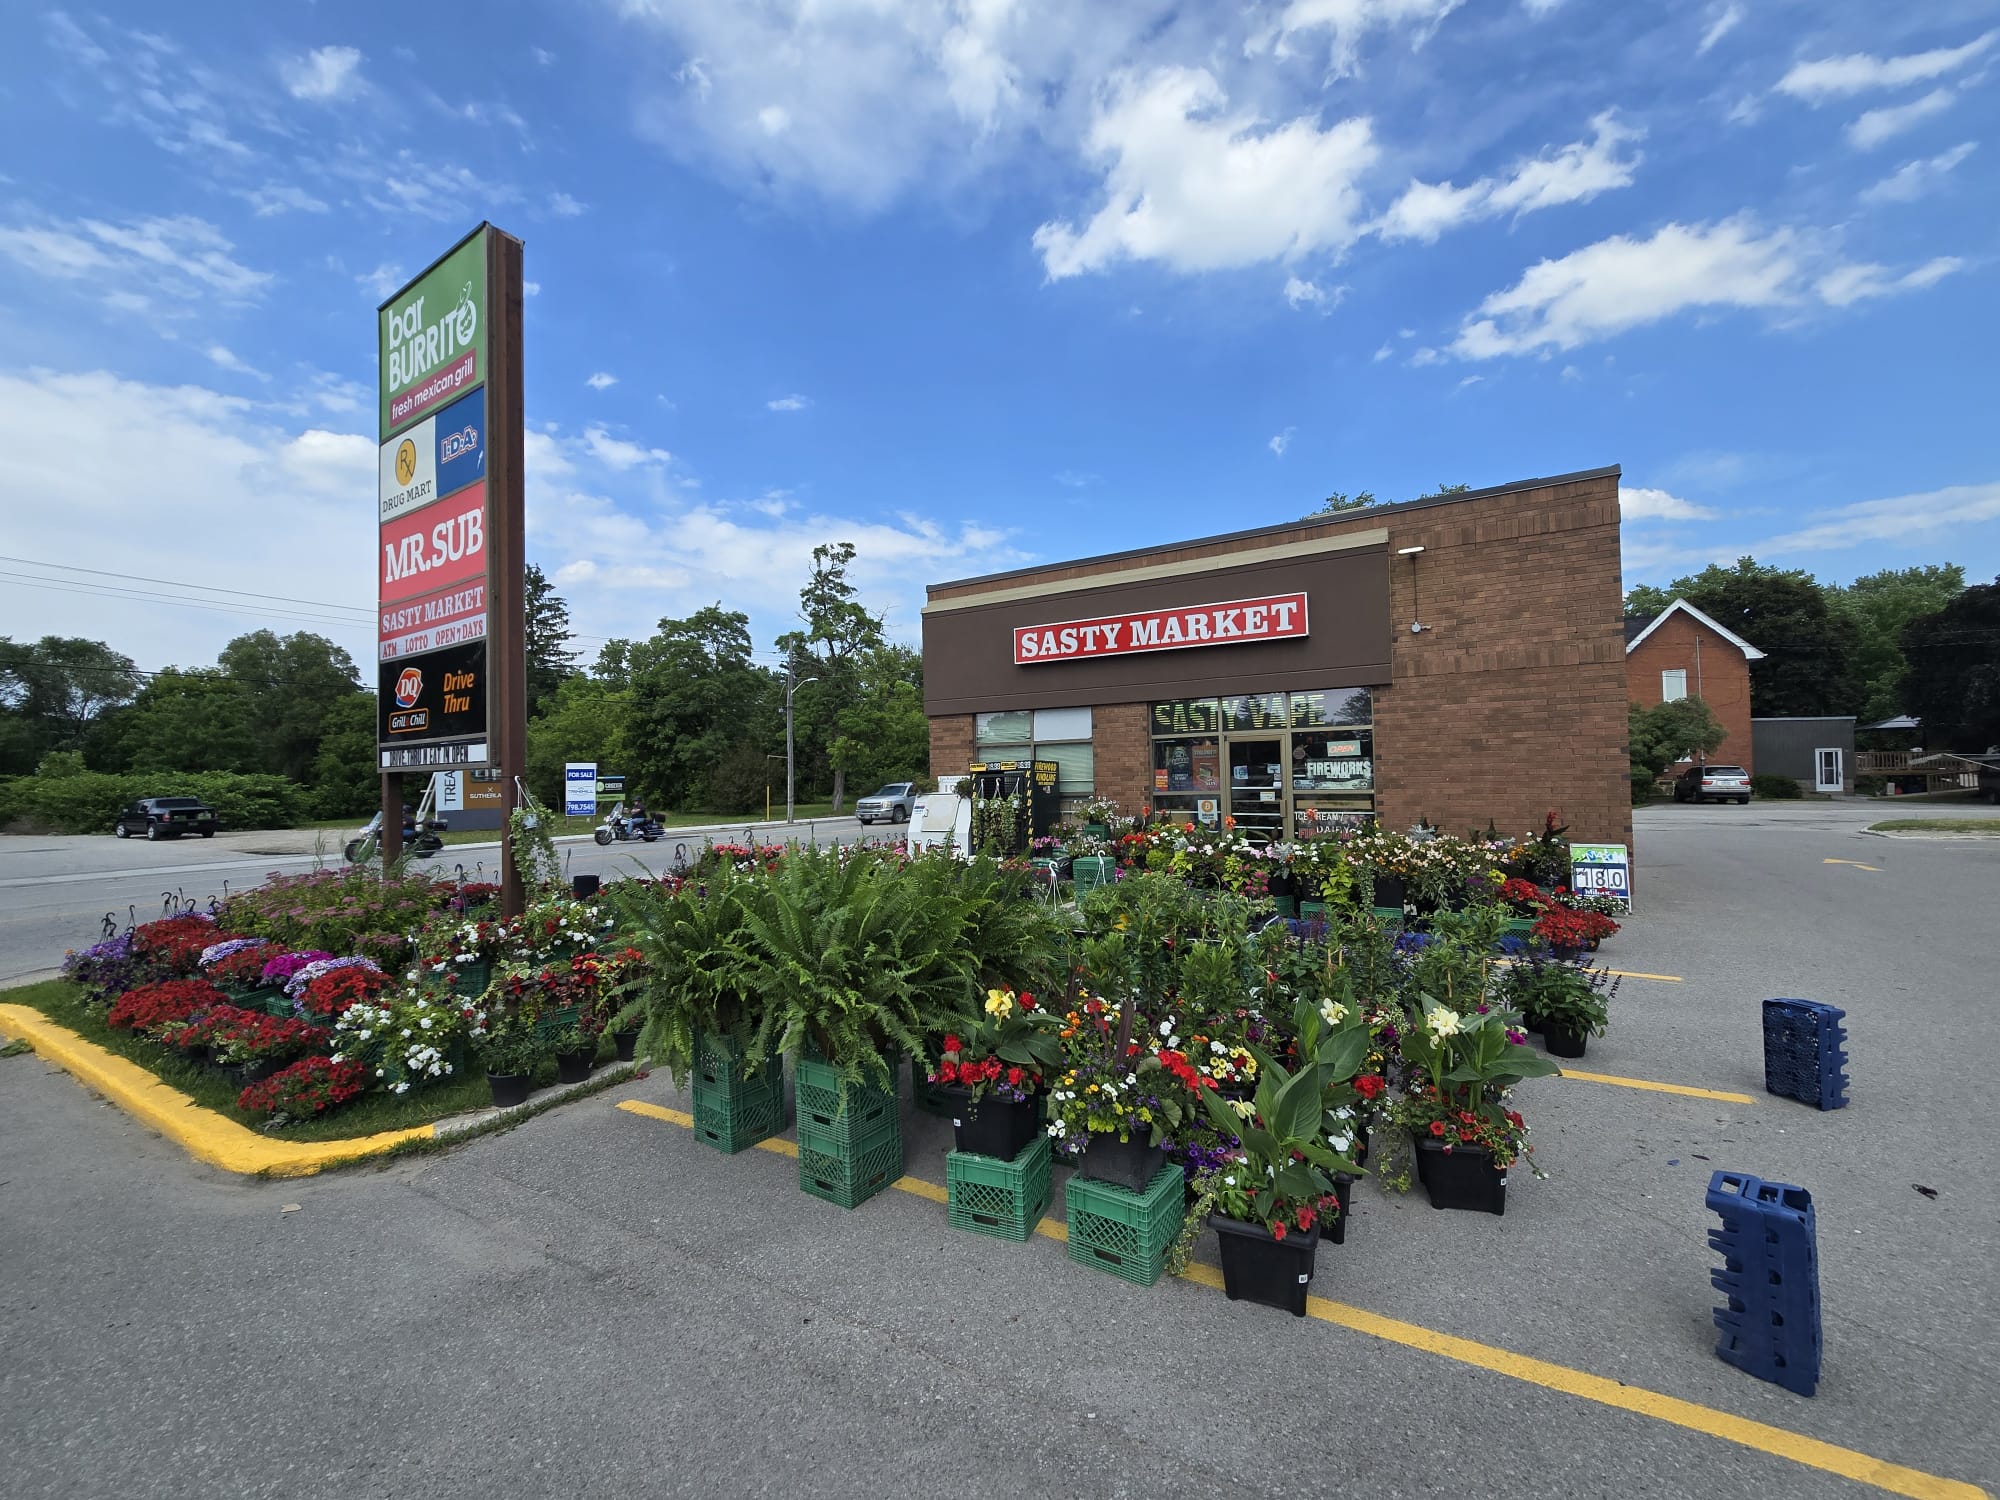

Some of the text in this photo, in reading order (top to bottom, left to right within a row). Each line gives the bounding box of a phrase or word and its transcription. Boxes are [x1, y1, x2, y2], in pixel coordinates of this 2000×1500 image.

[389, 296, 424, 350] bar
[389, 300, 477, 393] BURRITO
[392, 356, 473, 420] fresh mexican grill
[382, 480, 432, 513] DRUG MART
[382, 586, 484, 633] SASTY MARKET
[382, 619, 484, 658] ATM LOTTO OPEN 7 DAYS
[1021, 601, 1298, 658] SASTY MARKET
[400, 677, 417, 697] DQ
[443, 670, 475, 692] Drive
[443, 693, 470, 714] Thru
[1248, 694, 1326, 728] VAPE
[391, 715, 406, 728] Grill
[410, 713, 426, 726] Chill
[454, 745, 469, 763] OPEN
[1329, 744, 1356, 754] OPEN
[1306, 761, 1372, 779] FIREWORKS
